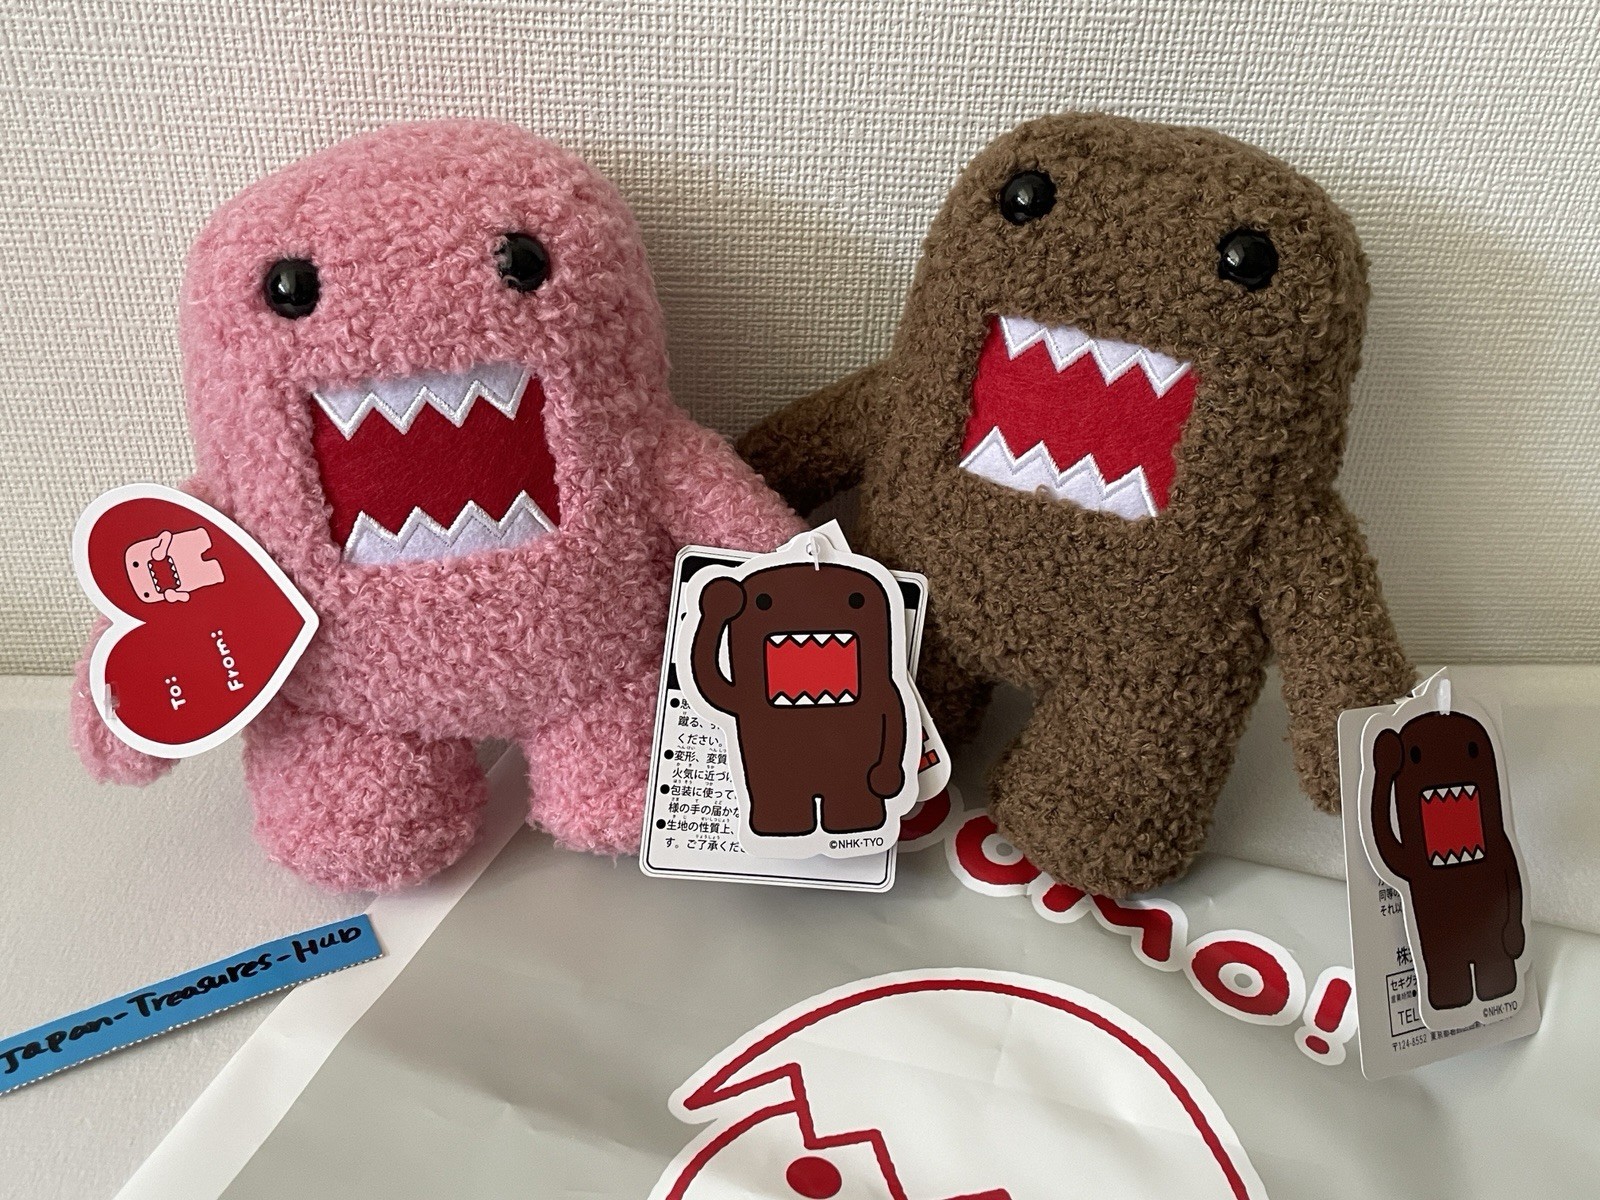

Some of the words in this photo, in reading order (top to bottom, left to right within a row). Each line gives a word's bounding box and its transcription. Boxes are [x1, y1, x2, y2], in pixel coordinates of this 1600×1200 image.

[211, 630, 244, 691] From:
[678, 733, 722, 748] ください。
[671, 784, 737, 799] 包装に使って
[1398, 1008, 1419, 1025] TEL
